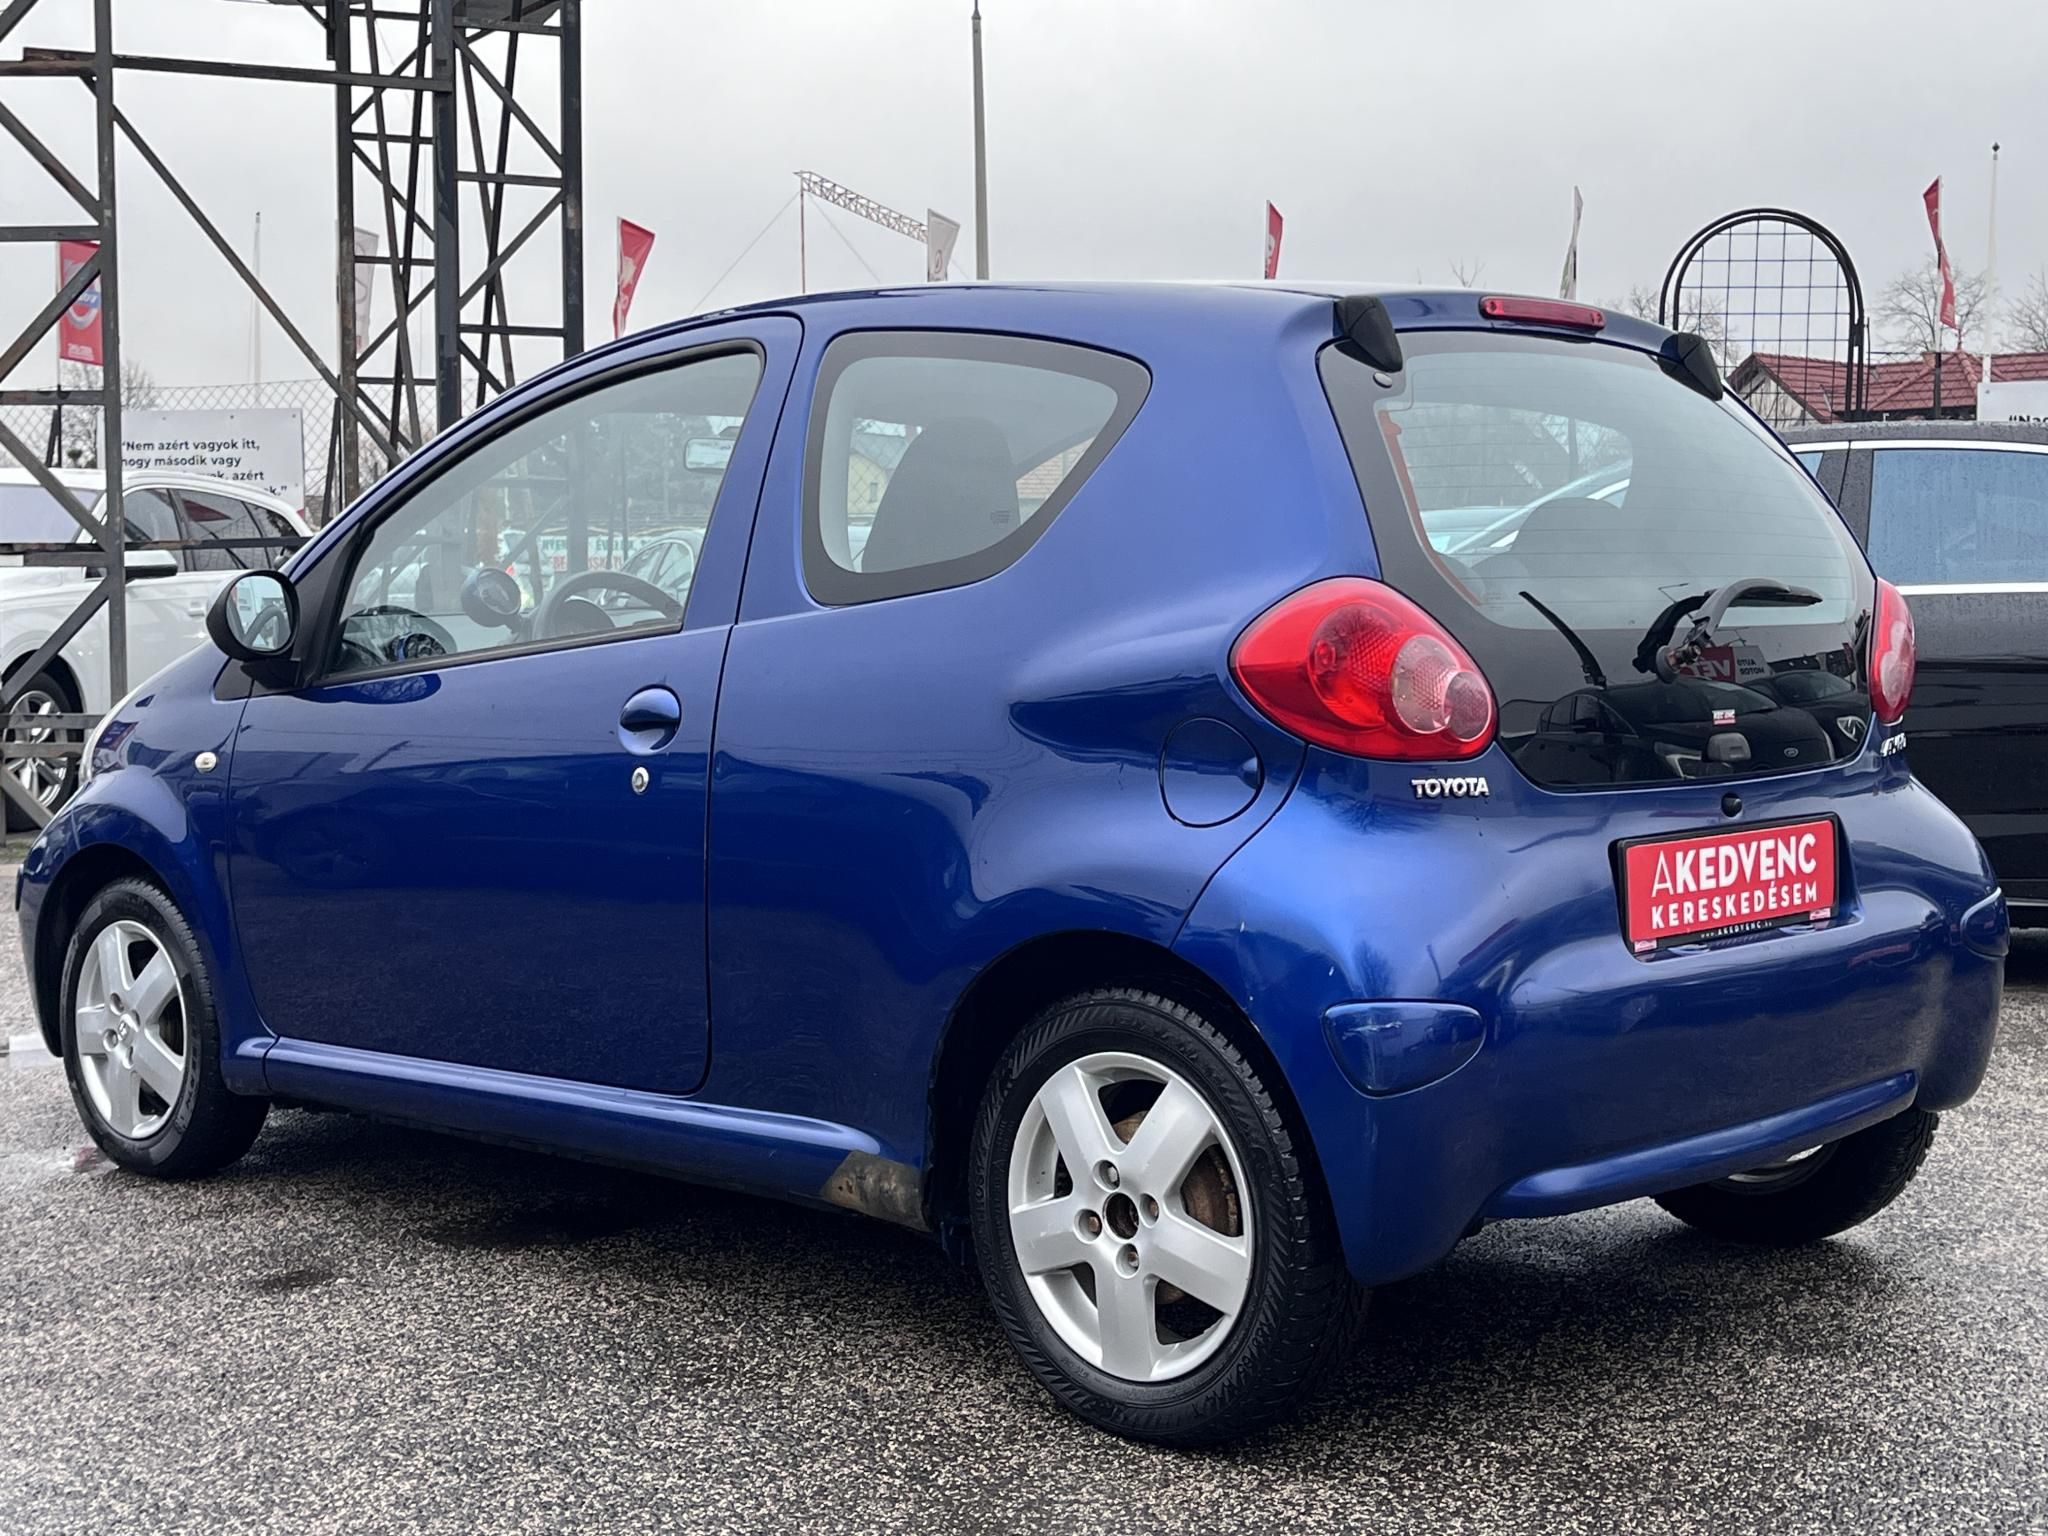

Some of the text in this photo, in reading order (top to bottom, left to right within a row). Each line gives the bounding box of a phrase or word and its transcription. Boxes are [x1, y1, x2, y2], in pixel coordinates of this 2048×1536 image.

[158, 438, 190, 452] azért
[193, 438, 239, 453] vagyok
[242, 438, 261, 452] itt,
[155, 455, 207, 467] második
[211, 456, 242, 468] vagy
[232, 469, 265, 481] azért
[1411, 777, 1490, 798] TOYOTA
[1652, 880, 1818, 930] KERESKEDÉSEM
